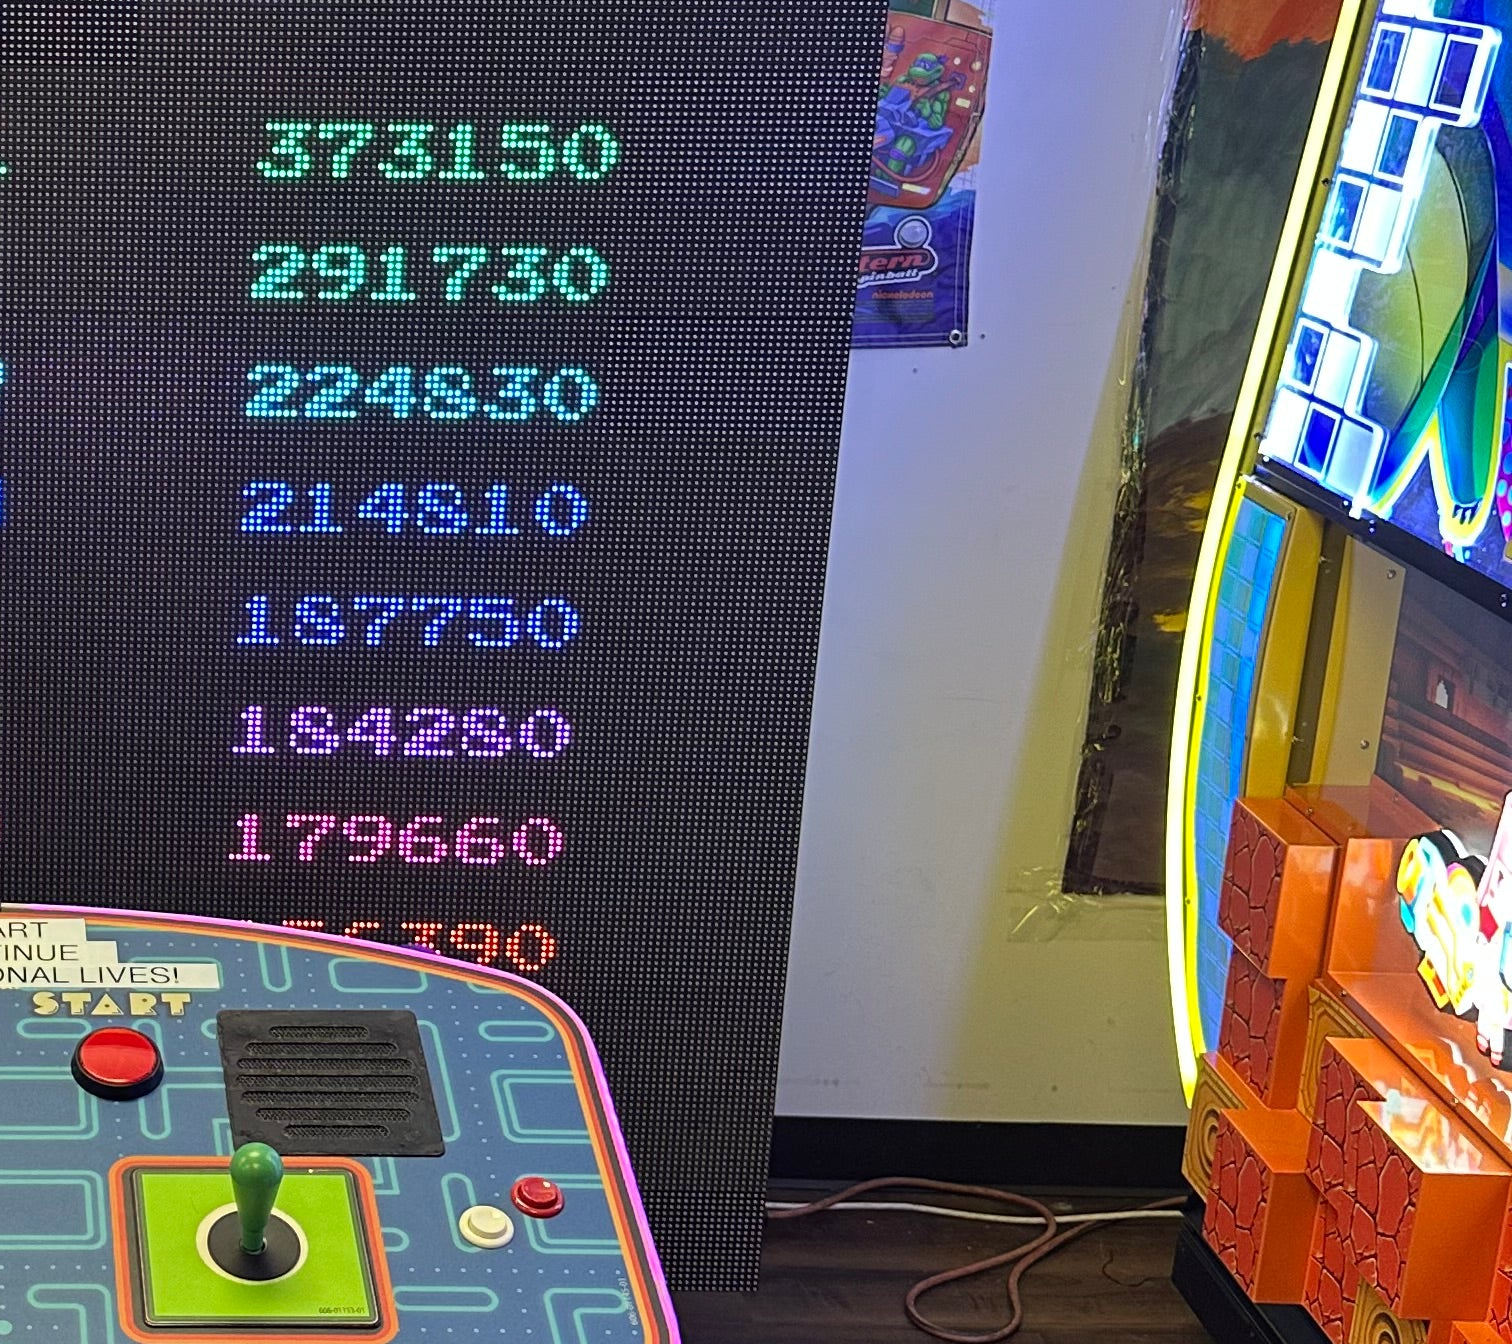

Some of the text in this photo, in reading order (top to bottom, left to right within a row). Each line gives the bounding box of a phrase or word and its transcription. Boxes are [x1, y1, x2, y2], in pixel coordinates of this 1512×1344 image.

[256, 121, 619, 181] 373150
[250, 244, 610, 302] 291730
[859, 254, 923, 273] tern
[245, 364, 597, 421] 224830
[240, 481, 588, 536] 214810
[236, 593, 581, 649] 187750
[231, 704, 572, 759] 184280
[228, 813, 564, 866] 179660
[80, 966, 180, 984] LIVES!
[32, 991, 191, 1016] START
